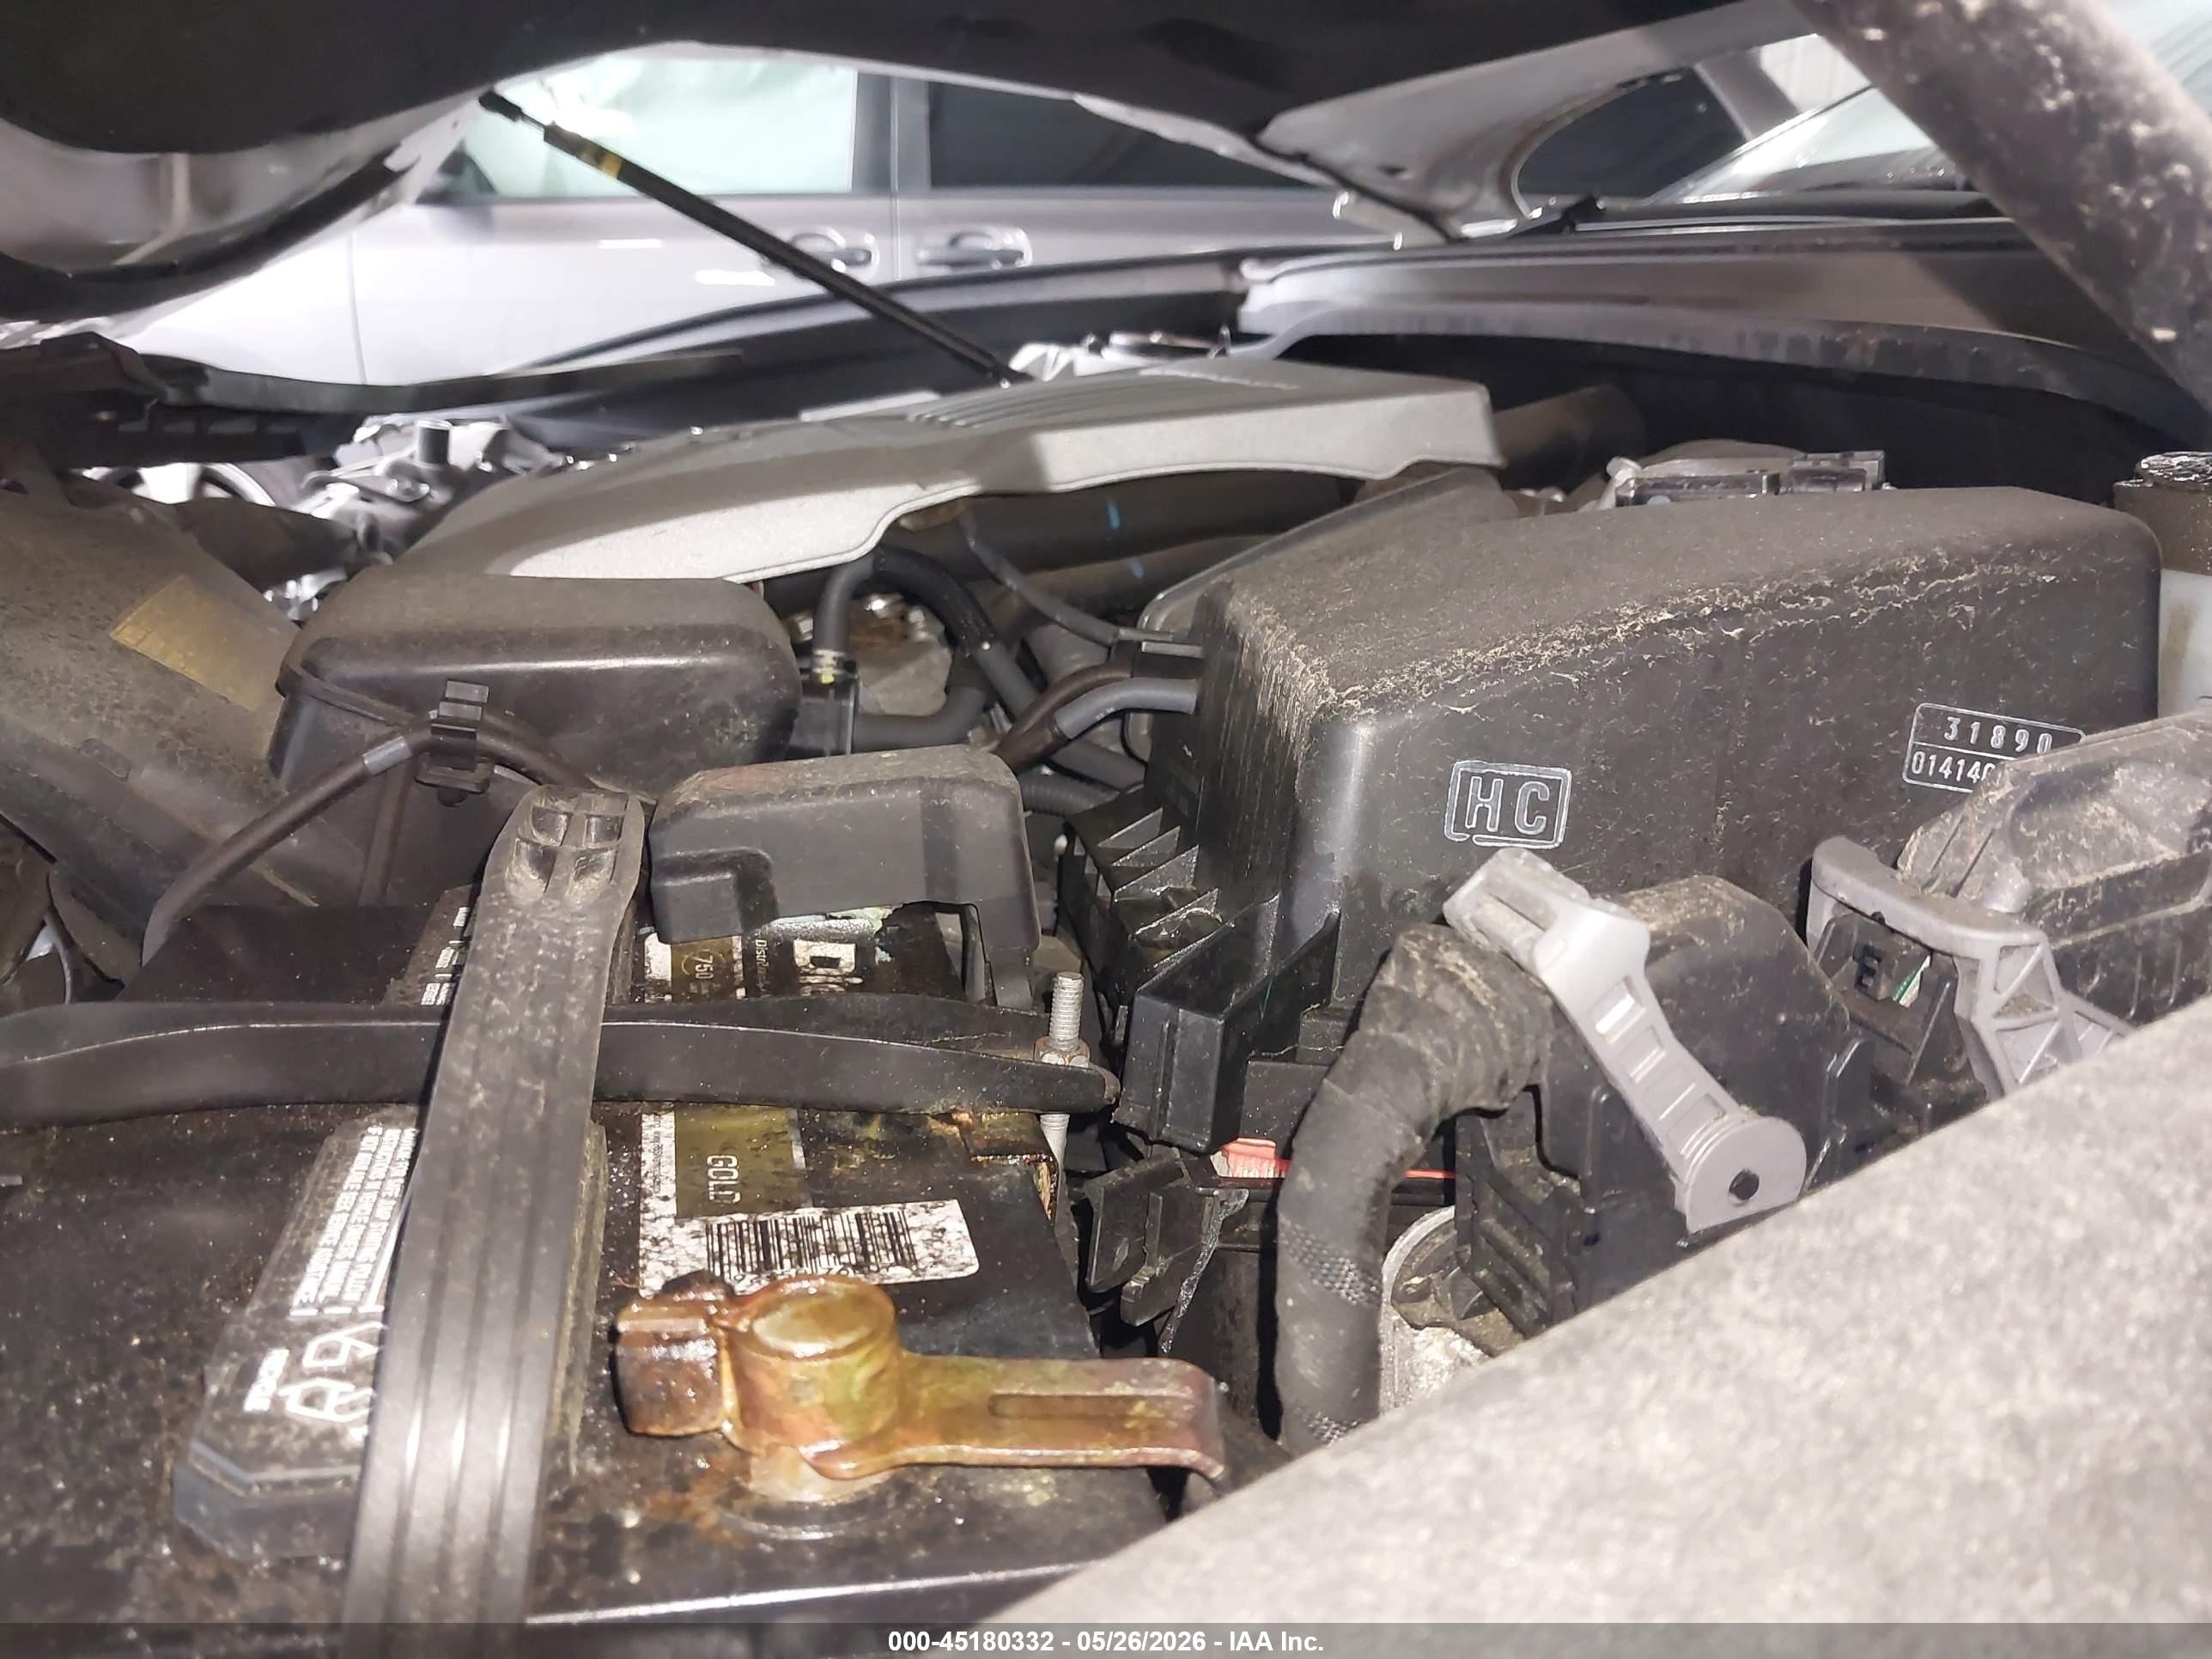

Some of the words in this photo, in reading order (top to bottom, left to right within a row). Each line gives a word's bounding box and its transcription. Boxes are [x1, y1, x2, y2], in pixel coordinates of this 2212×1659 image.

[1944, 716, 2053, 755] 31890
[1465, 775, 1550, 835] HC
[694, 952, 714, 981] 750
[706, 1154, 741, 1204] GOLD
